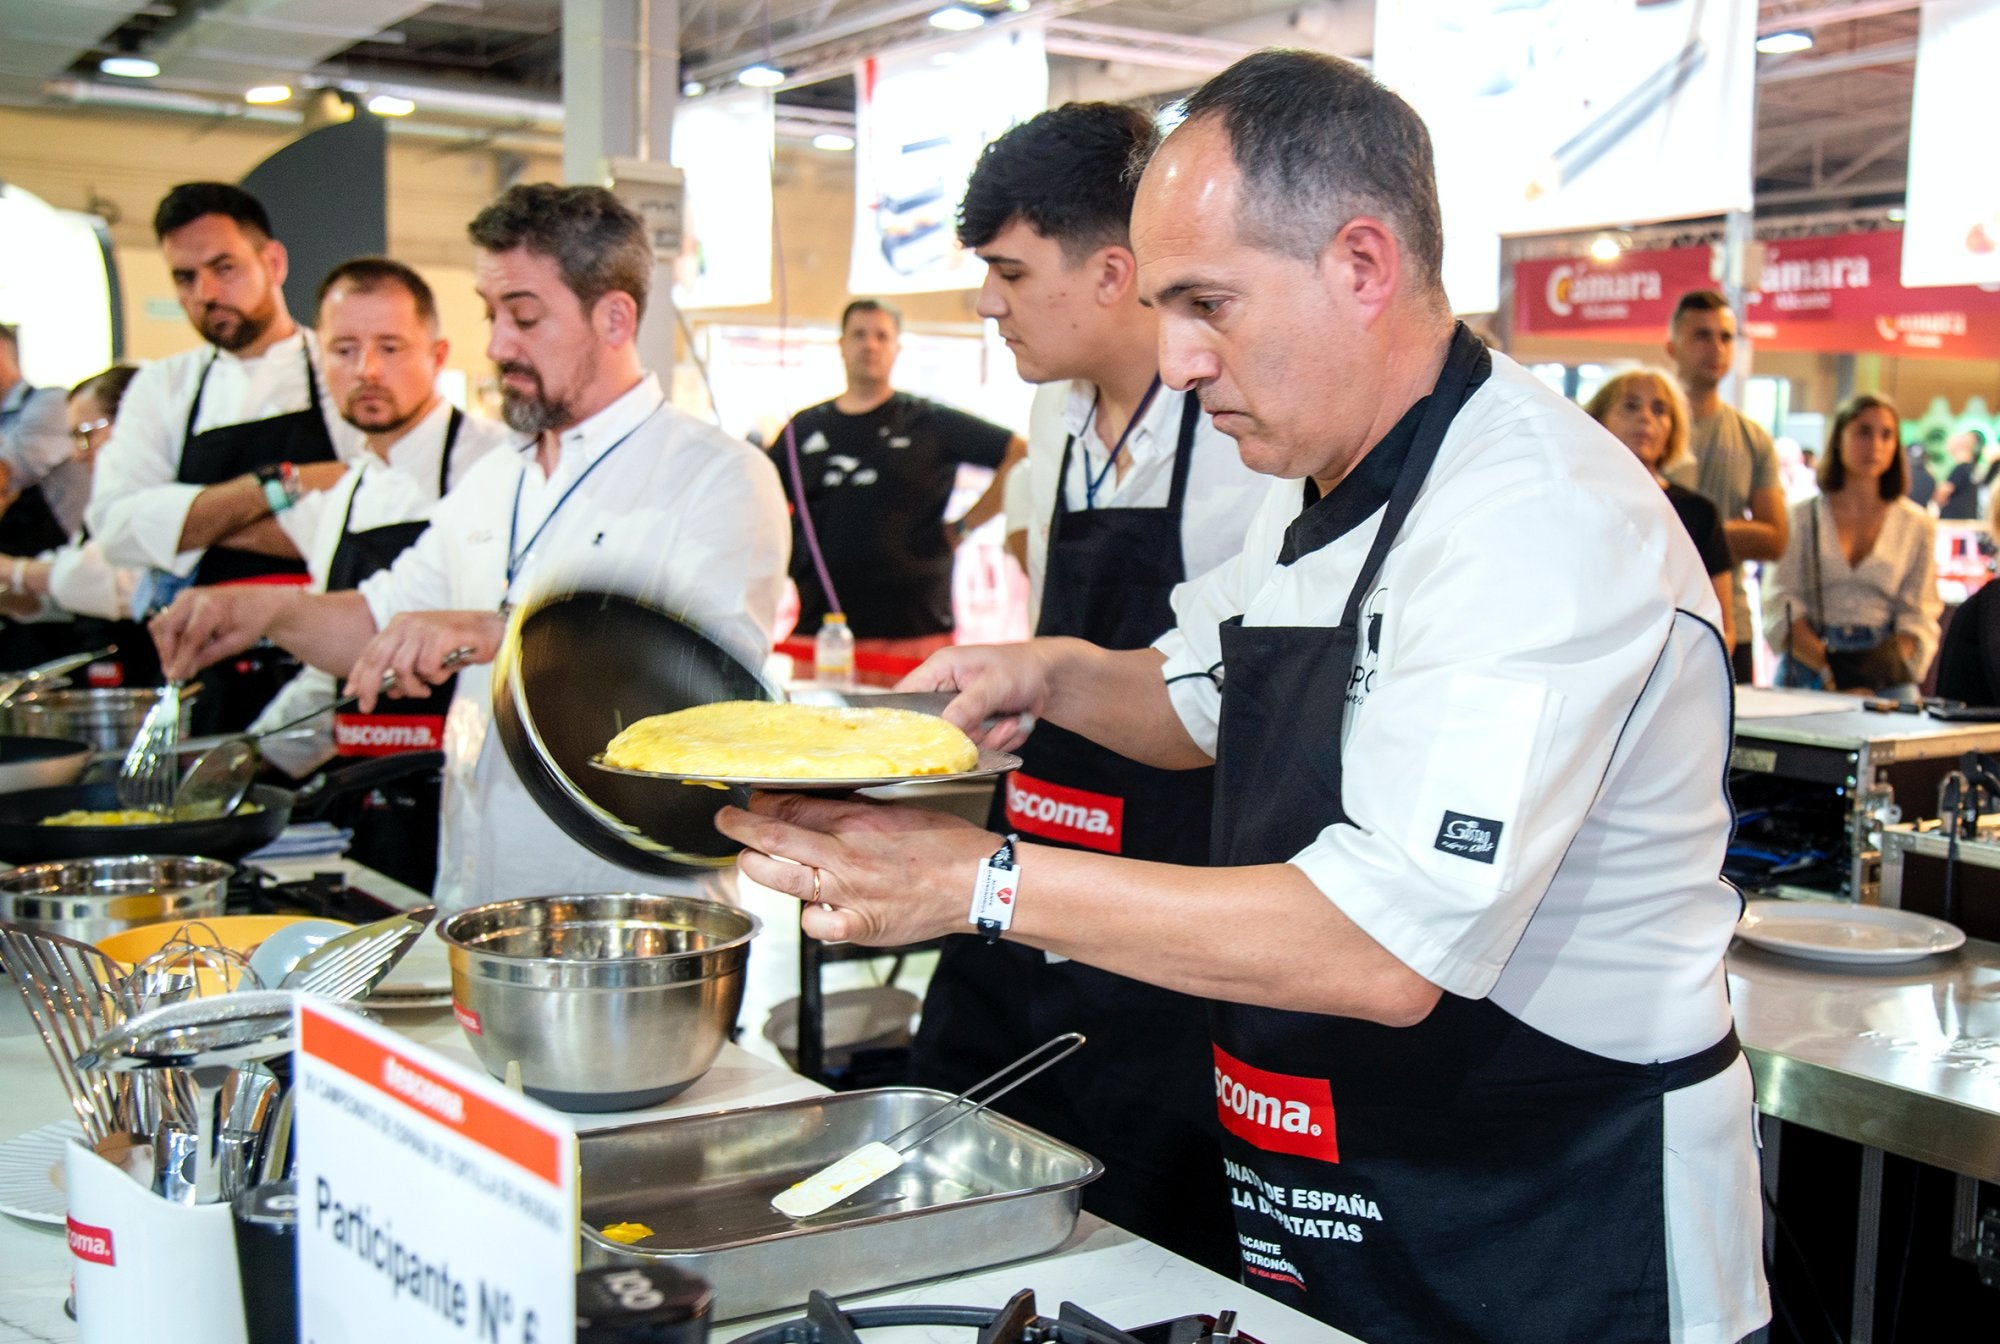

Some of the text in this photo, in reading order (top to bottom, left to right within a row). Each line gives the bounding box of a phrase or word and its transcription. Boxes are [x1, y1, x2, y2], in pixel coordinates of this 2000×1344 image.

[1230, 1187, 1256, 1211] LA
[1291, 1188, 1384, 1221] ESPAÑA
[317, 1175, 467, 1327] Participante
